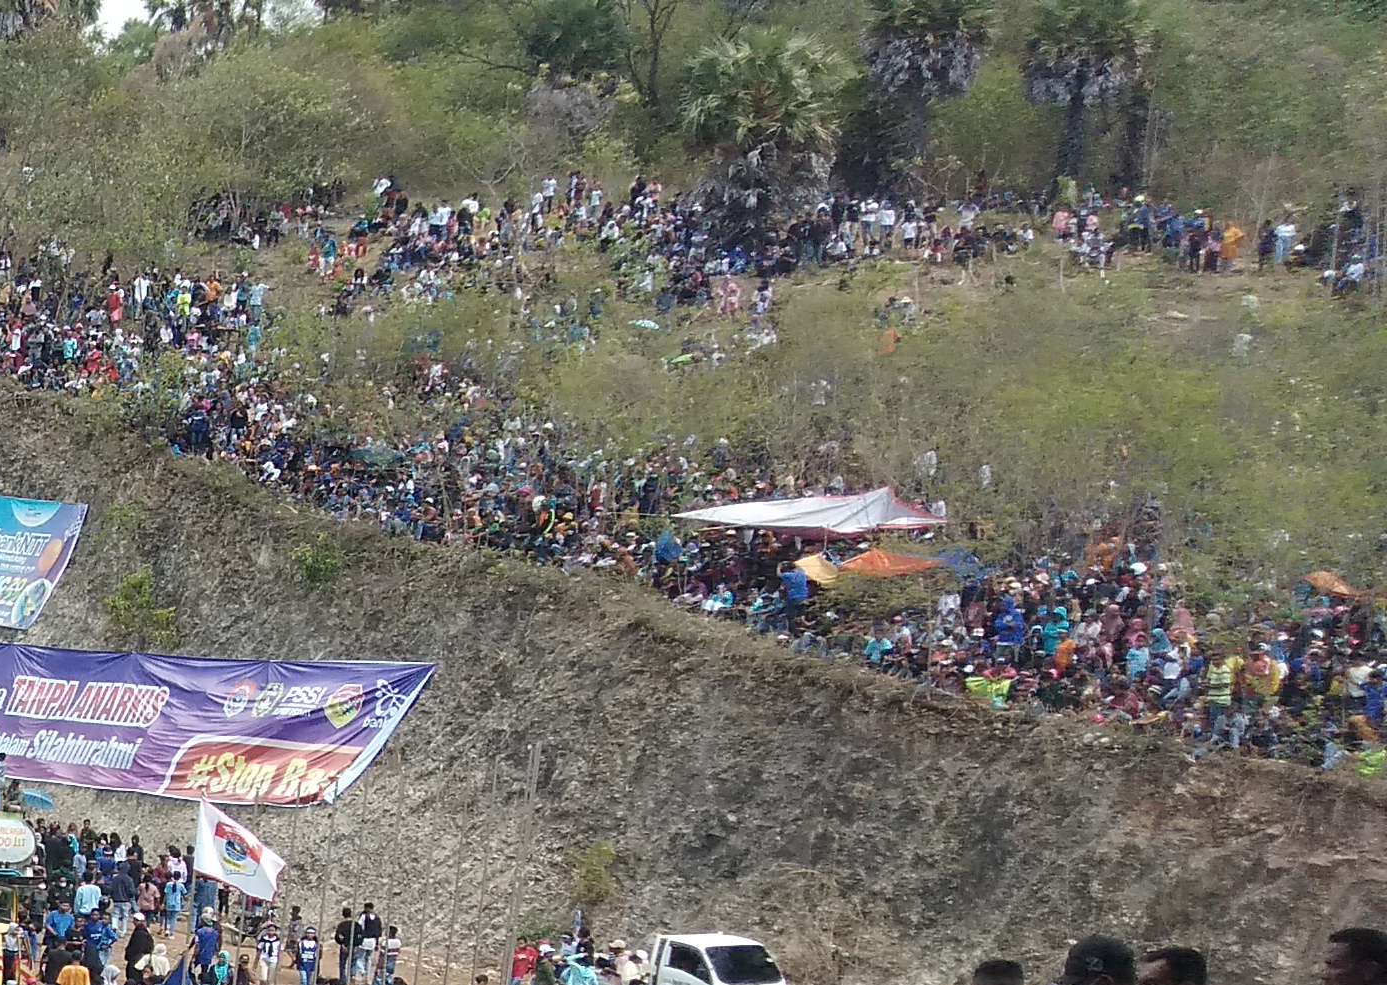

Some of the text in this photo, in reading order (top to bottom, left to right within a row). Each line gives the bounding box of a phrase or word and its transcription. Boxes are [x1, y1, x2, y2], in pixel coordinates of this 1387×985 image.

[5, 674, 78, 720] TANPA
[69, 681, 171, 728] ANARKIS
[281, 685, 328, 704] PSSI
[184, 751, 278, 800] #Stop
